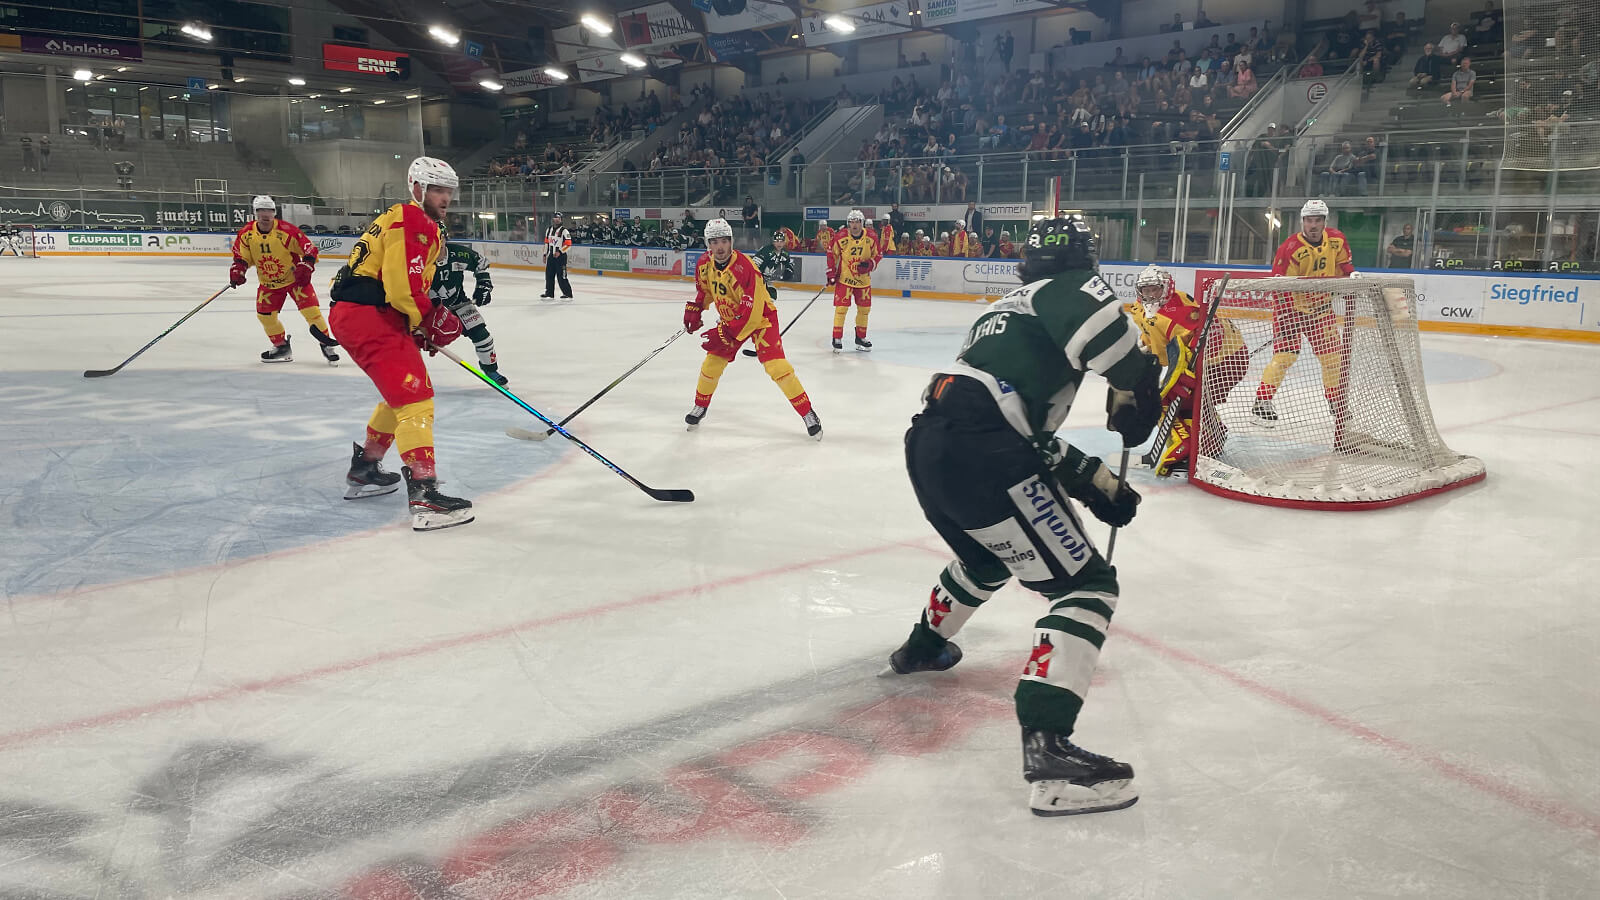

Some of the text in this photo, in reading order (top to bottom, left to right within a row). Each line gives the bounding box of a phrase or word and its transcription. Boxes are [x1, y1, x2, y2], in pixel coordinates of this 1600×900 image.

[260, 243, 271, 254] 11
[850, 246, 863, 256] 27
[645, 252, 667, 266] marti
[1312, 256, 1327, 272] 16
[975, 264, 1017, 276] SCHERRE
[1490, 283, 1580, 305] Siegfried
